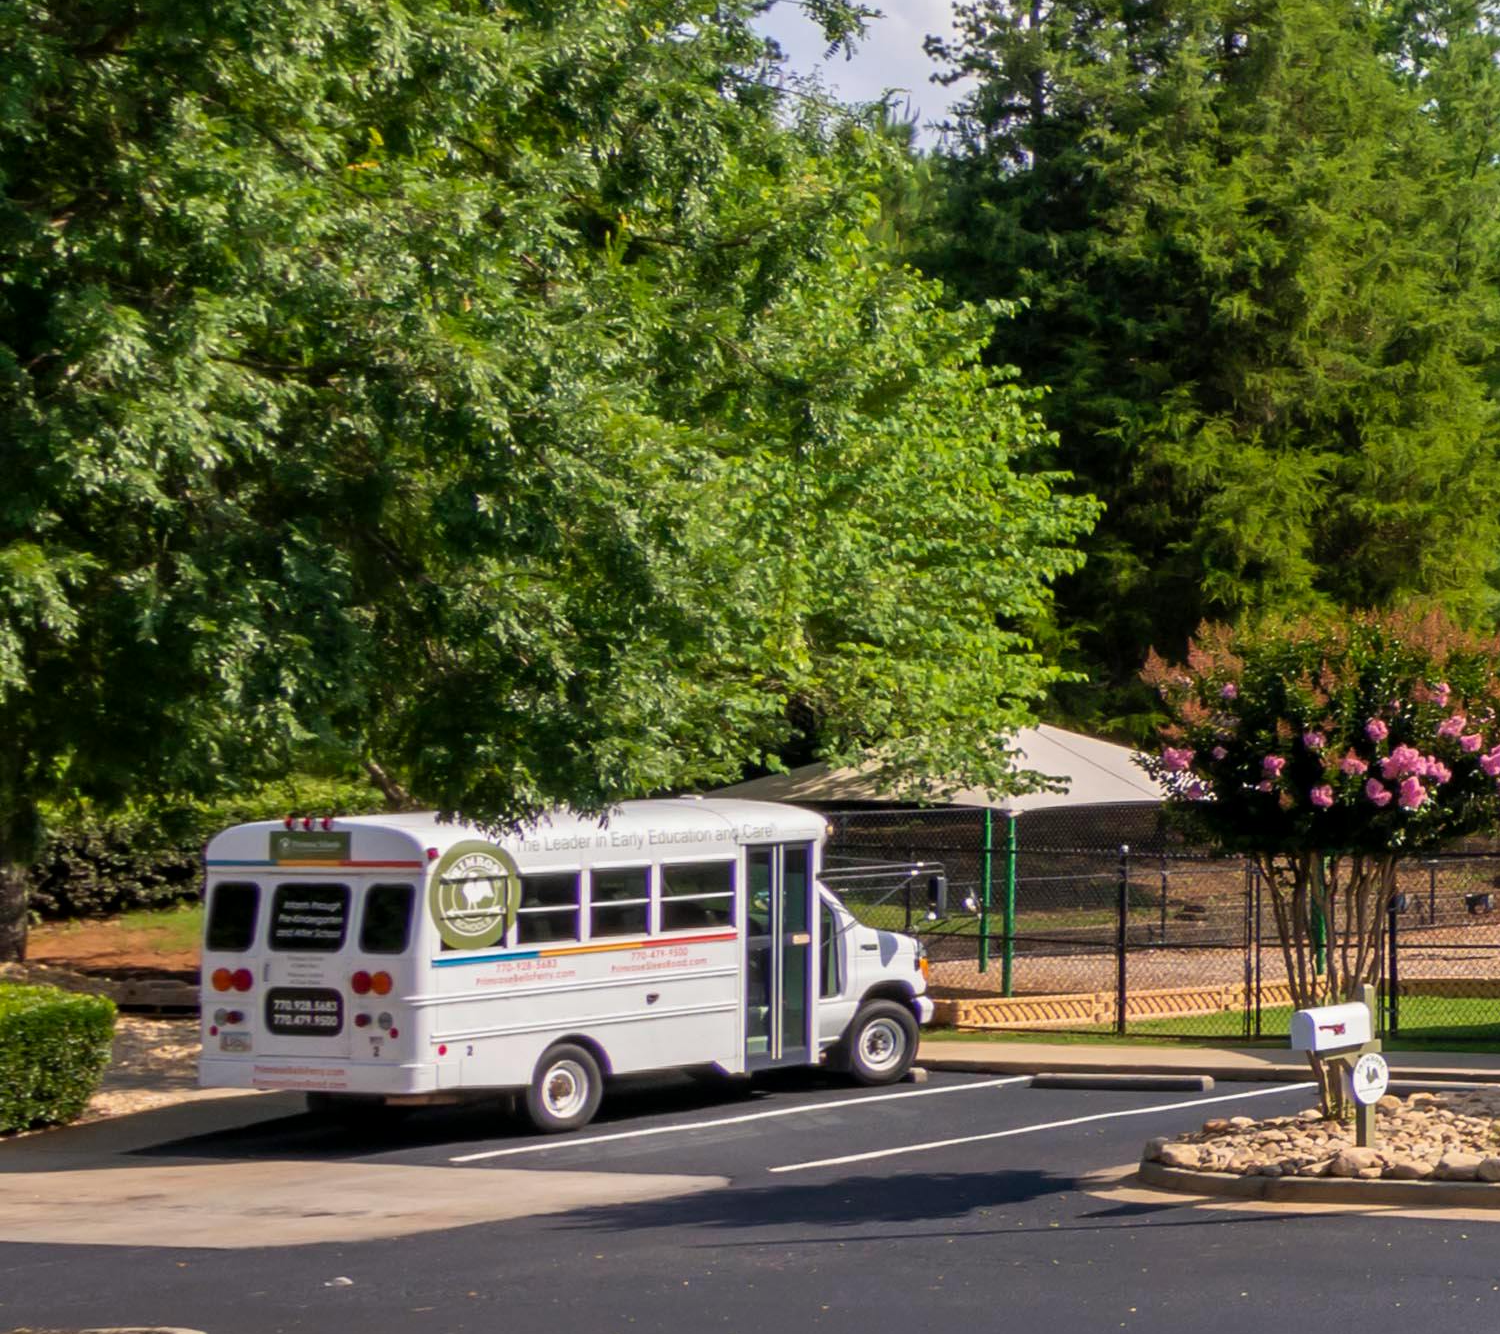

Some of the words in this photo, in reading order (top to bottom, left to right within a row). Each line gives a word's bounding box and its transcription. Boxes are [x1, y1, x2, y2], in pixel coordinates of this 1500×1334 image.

[515, 837, 540, 852] The
[544, 833, 591, 851] Leader
[595, 831, 607, 847] in
[611, 830, 643, 850] Early
[649, 827, 713, 845] Education
[715, 826, 738, 842] and
[466, 1045, 473, 1056] 2
